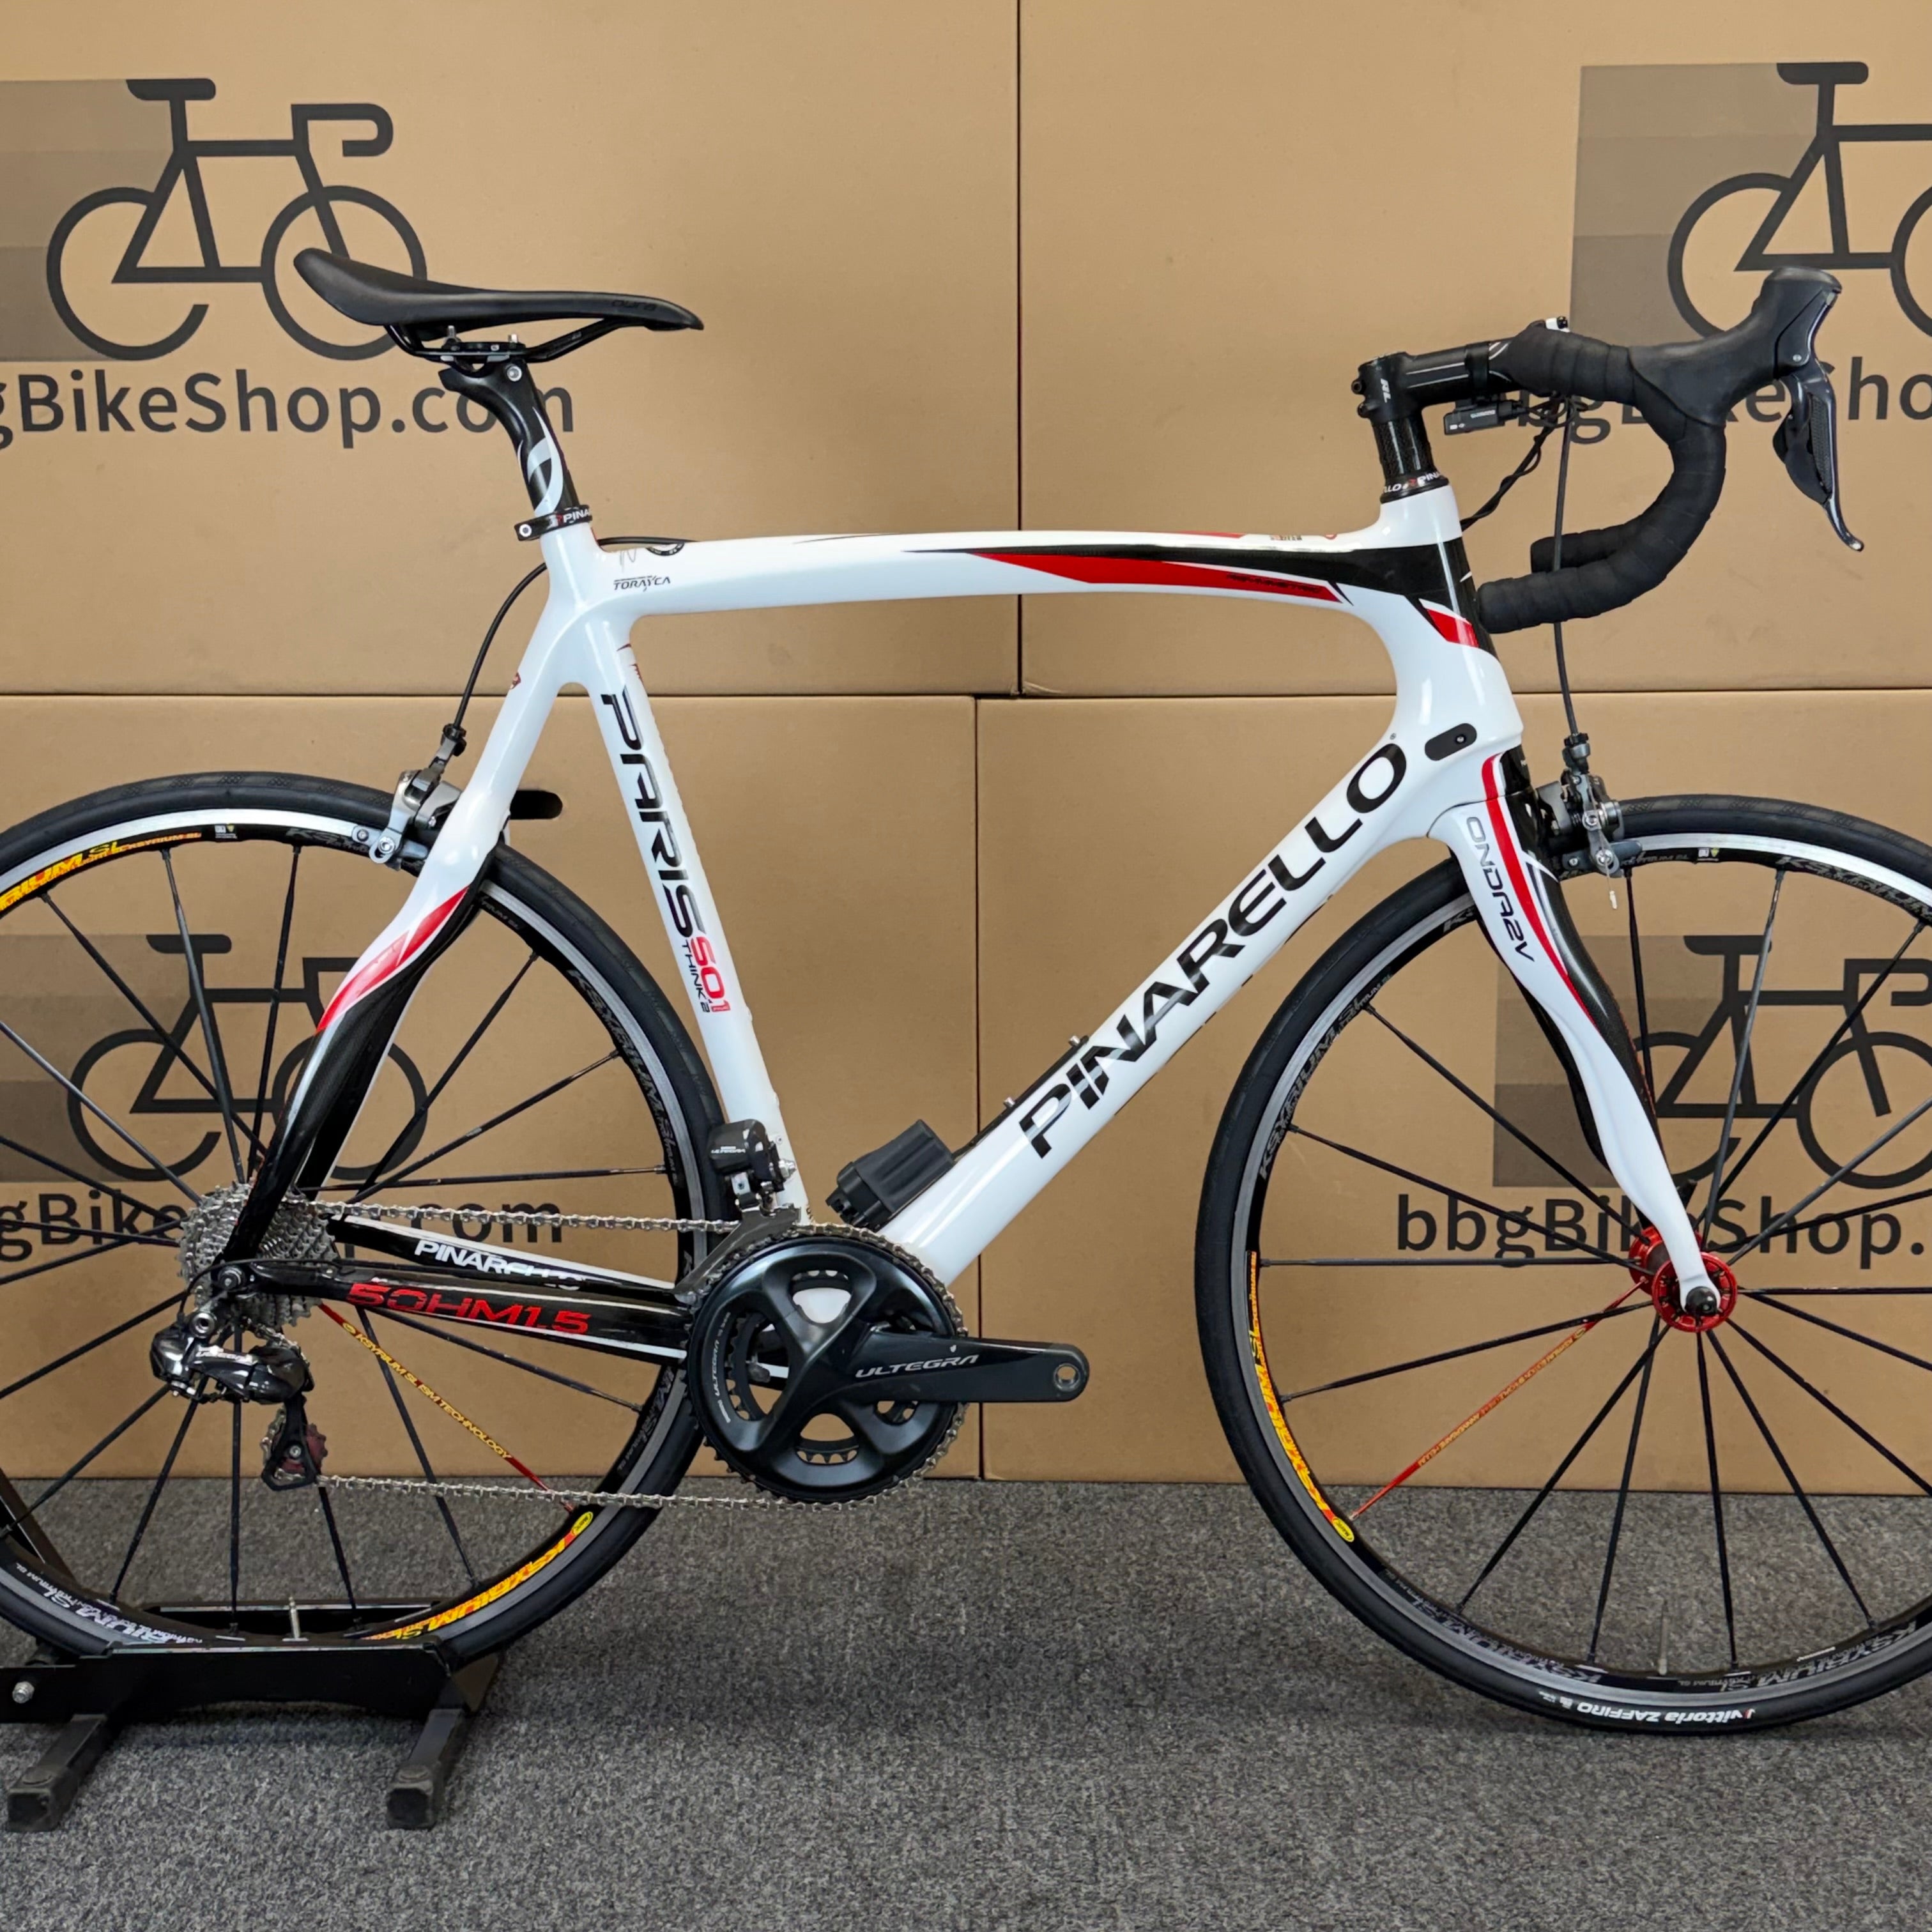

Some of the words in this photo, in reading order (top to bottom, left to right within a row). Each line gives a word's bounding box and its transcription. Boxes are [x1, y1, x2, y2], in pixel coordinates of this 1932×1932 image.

[0, 369, 574, 448] BikeShop.co
[613, 575, 671, 592] TORAYCA
[601, 685, 707, 937] PARIS
[1019, 742, 1407, 1159] PINARELLO
[1397, 1193, 1924, 1269] bbgBiShop.
[855, 1354, 979, 1378] ULTEGRA
[438, 1400, 512, 1459] TECHNOLOGY
[1577, 1702, 1661, 1722] ZAFFIRO
[1664, 1709, 1743, 1725] vittoria
